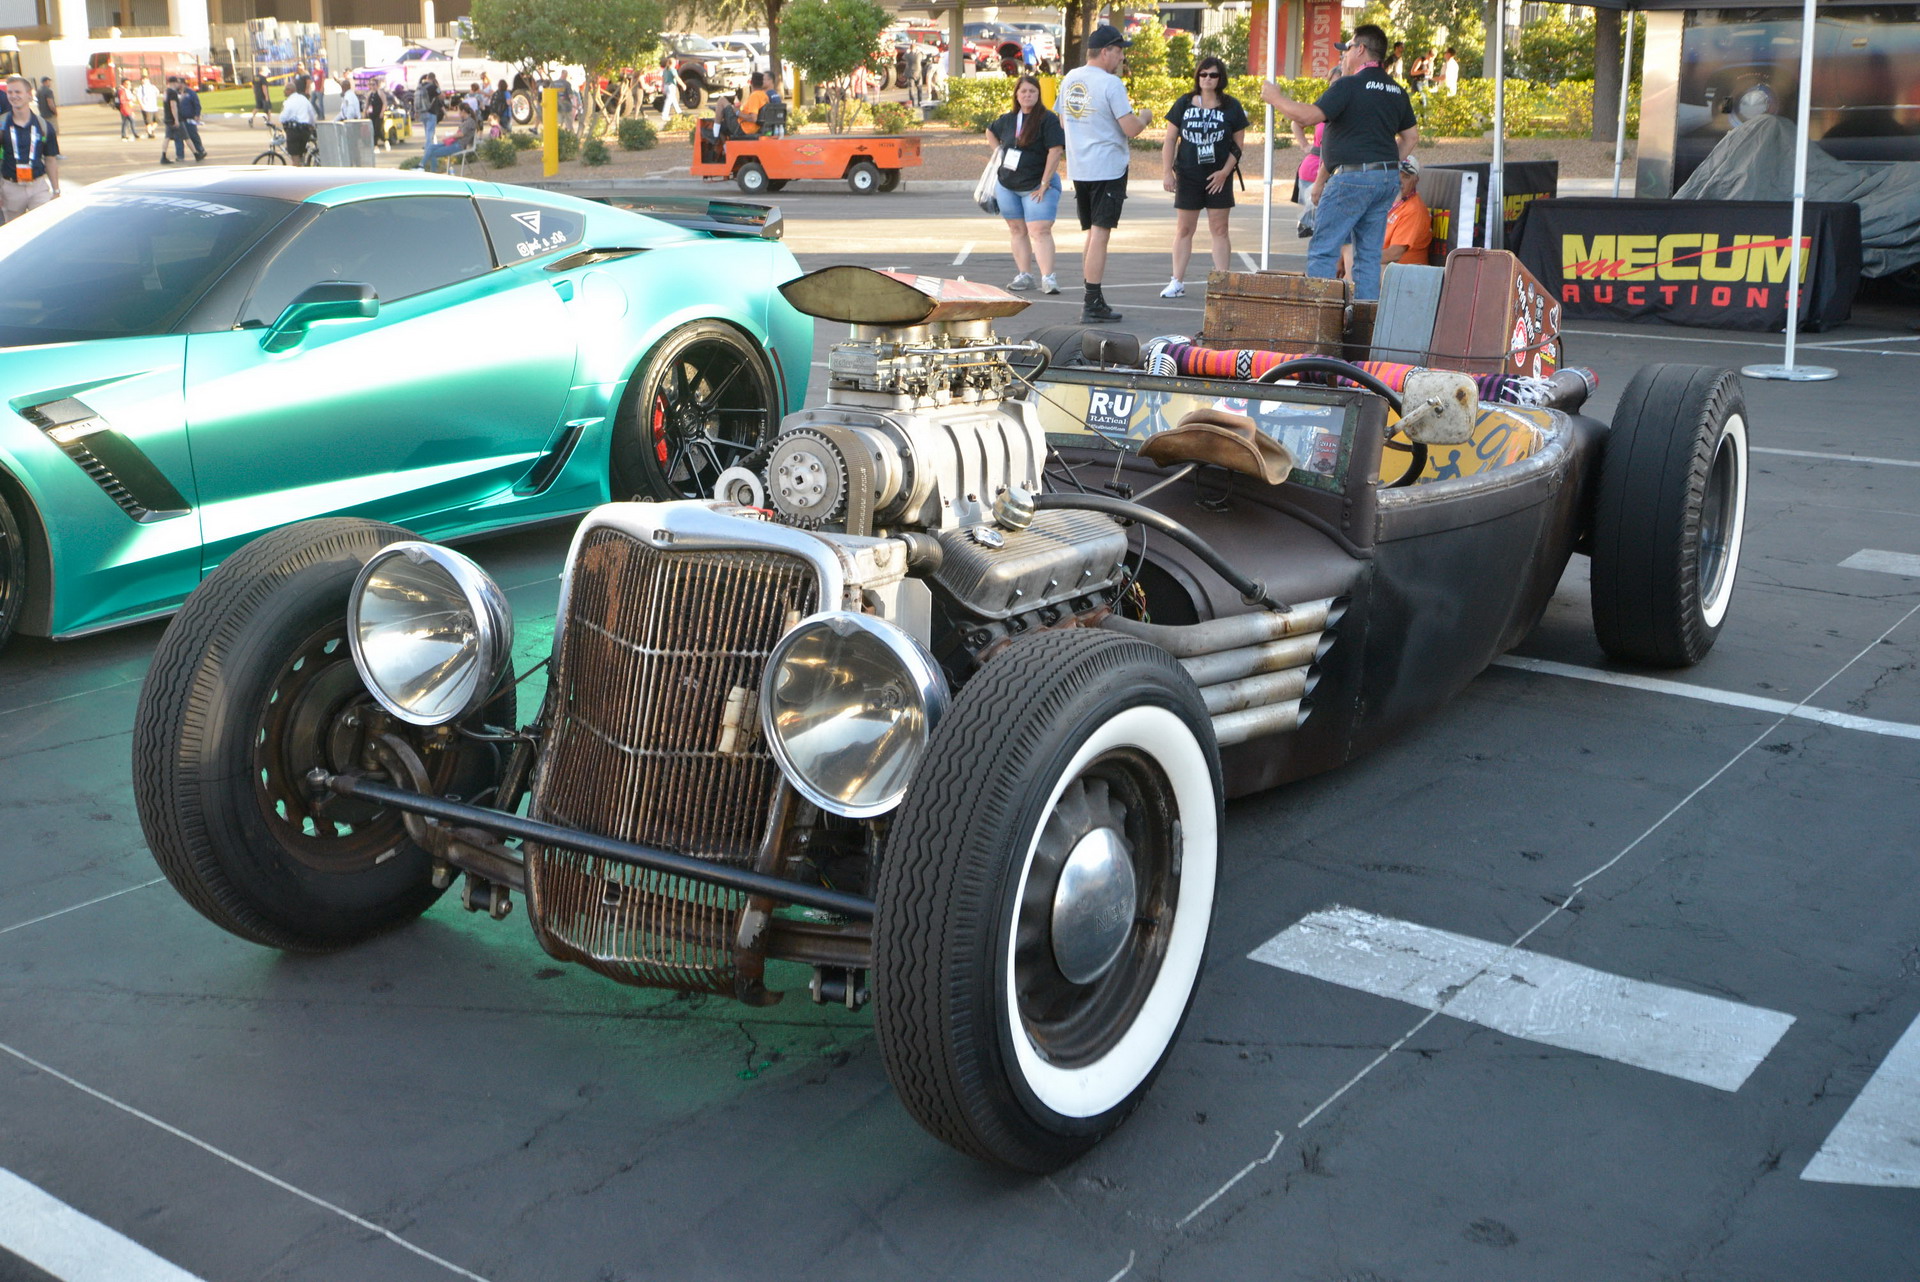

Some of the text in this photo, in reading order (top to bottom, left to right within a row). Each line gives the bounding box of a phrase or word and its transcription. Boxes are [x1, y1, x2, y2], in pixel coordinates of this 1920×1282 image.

[1313, 5, 1331, 35] LAS
[1311, 38, 1330, 79] VEGA
[1365, 81, 1384, 91] CRAB
[1183, 107, 1225, 122] SIX PAK
[1503, 192, 1550, 222] MEC
[1561, 233, 1812, 284] MECUM
